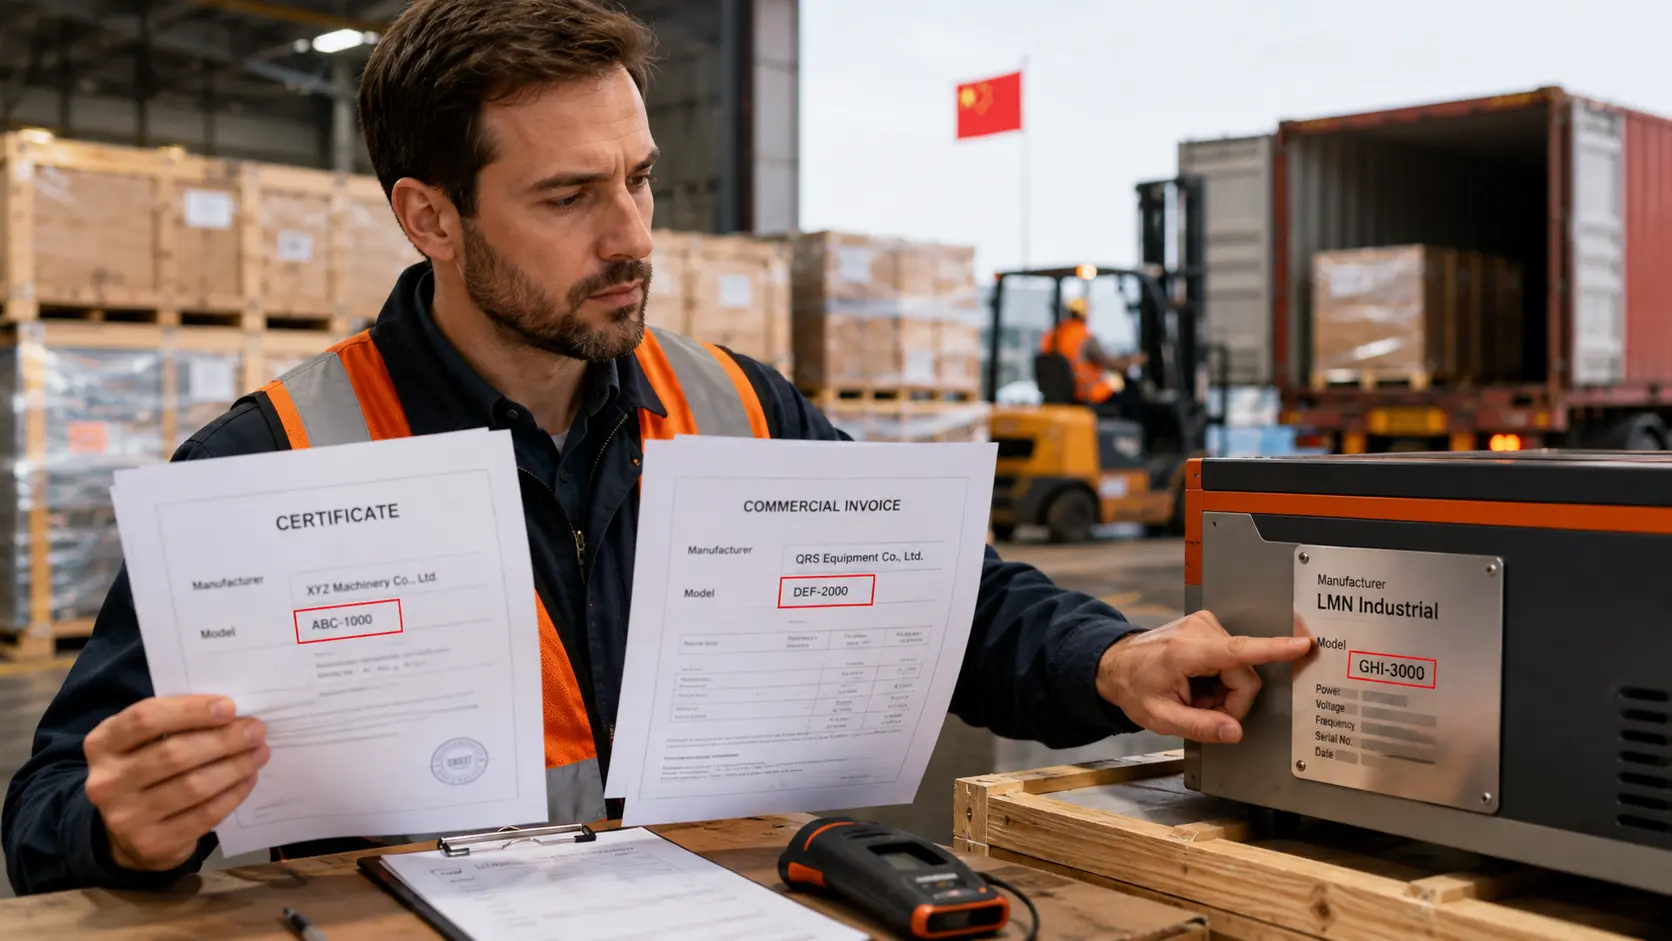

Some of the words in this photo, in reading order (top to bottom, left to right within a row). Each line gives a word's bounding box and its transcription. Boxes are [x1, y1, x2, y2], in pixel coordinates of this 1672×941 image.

[743, 499, 841, 513] COMMERCIAL
[844, 498, 902, 512] INVOICE
[276, 503, 400, 531] CERTIFICATE
[687, 544, 753, 556] Manufacturer
[795, 553, 820, 565] QRS
[823, 552, 878, 565] Equipment
[881, 551, 901, 563] Co.,
[904, 550, 923, 561] Ltd.
[192, 576, 264, 592] Manufacturer
[307, 584, 330, 596] XYZ
[333, 579, 390, 593] Machinery
[418, 572, 438, 583] Ltd.
[1317, 573, 1387, 590] Manufacturer
[684, 587, 715, 599] Model
[793, 585, 849, 597] DEF-2000
[1317, 592, 1353, 613] LMN
[1358, 596, 1439, 620] Industrial
[311, 614, 373, 631] ABC-1000
[200, 626, 236, 640] Model
[1316, 636, 1347, 651] Model
[1358, 659, 1426, 681] GHI-3000
[1315, 683, 1341, 697] Power
[1315, 699, 1346, 714] Voltage
[1315, 715, 1356, 732] Frequency
[1315, 730, 1338, 744] Serial
[1339, 735, 1354, 747] No.
[1314, 745, 1334, 759] Date
